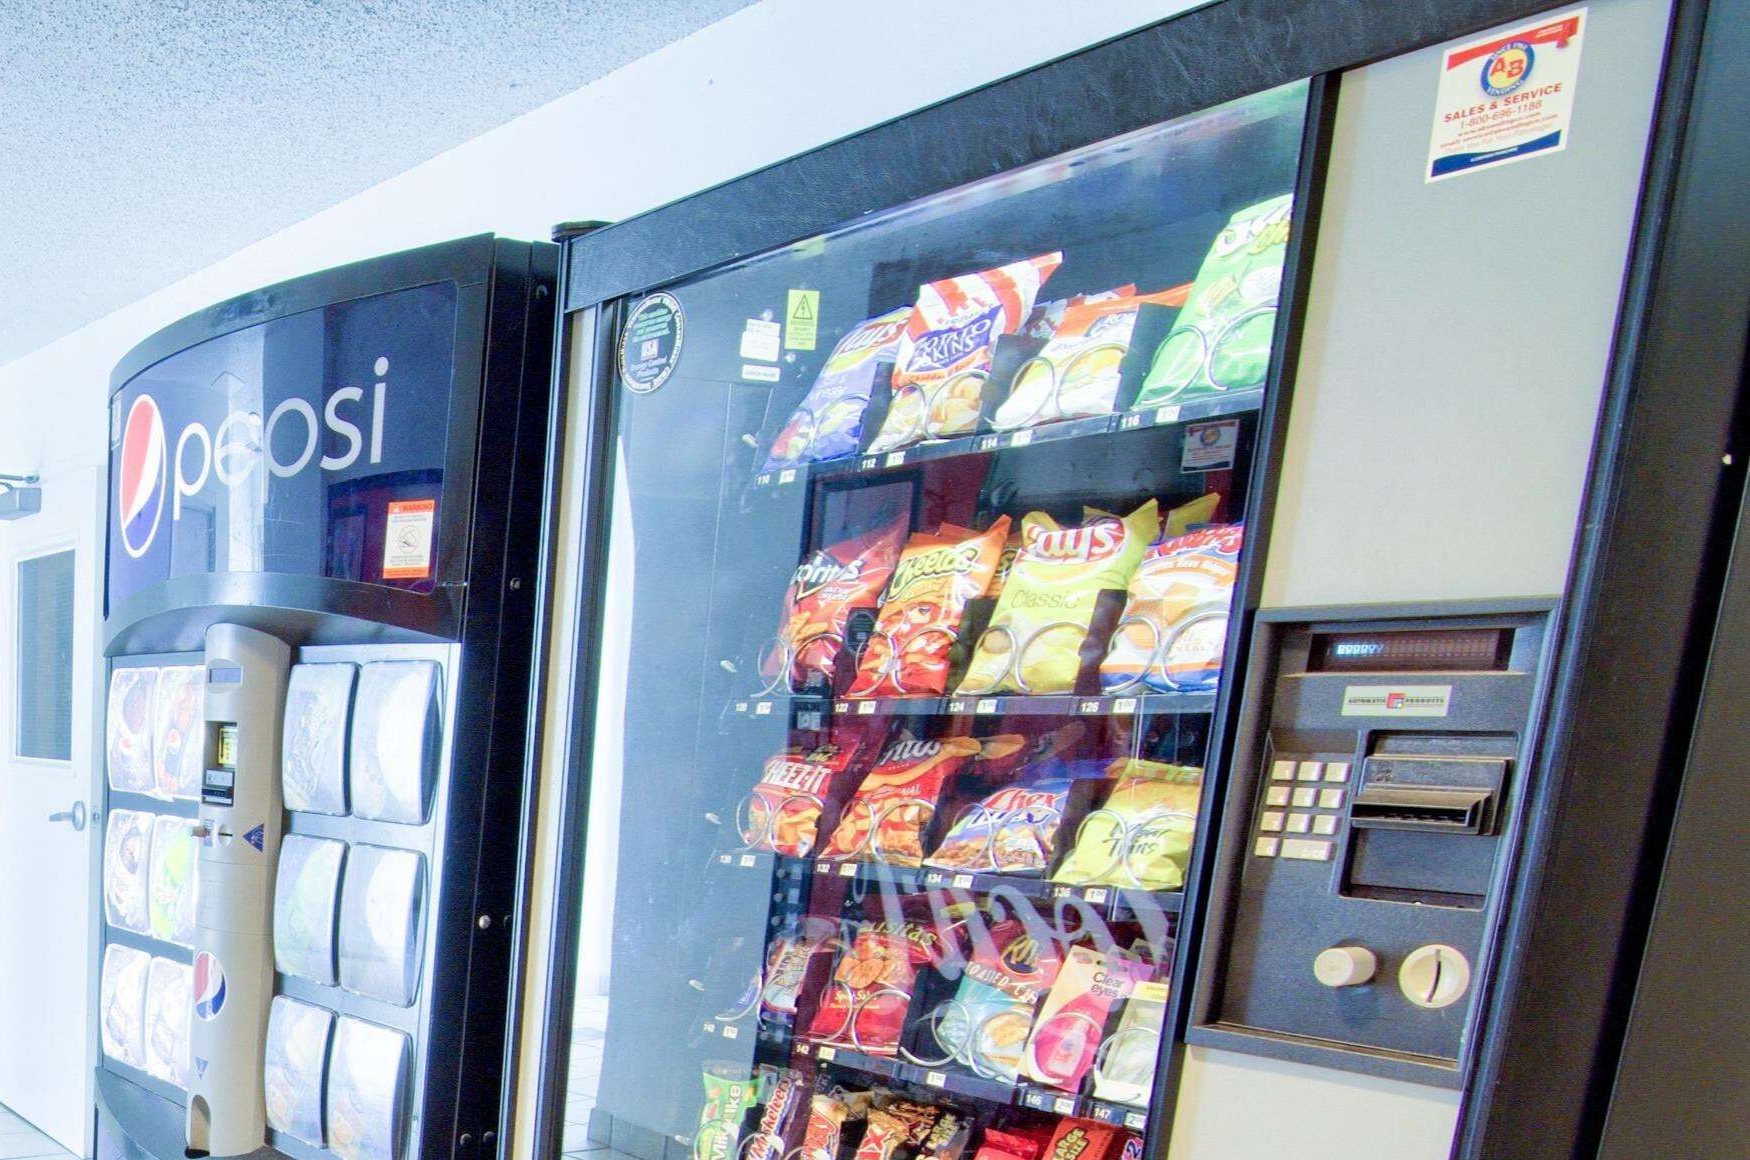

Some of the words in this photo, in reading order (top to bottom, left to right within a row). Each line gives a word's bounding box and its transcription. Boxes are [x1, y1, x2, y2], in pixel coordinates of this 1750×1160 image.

[1443, 104, 1485, 123] SALES
[1489, 101, 1499, 110] &
[1504, 82, 1563, 106] SERVICE
[1121, 414, 1140, 429] 116
[172, 356, 389, 521] pepsi
[981, 437, 998, 451] 114
[862, 458, 877, 469] 112
[890, 546, 979, 599] Cheetos
[1011, 589, 1080, 609] Classic
[1348, 697, 1387, 705] AUTOMATIC
[1404, 696, 1445, 704] PRODUCTS
[835, 702, 850, 714] 122
[950, 702, 964, 713] 124
[1080, 702, 1098, 713] 126
[927, 873, 942, 884] 134
[1093, 970, 1126, 989] Clear
[1093, 1107, 1112, 1120] 147
